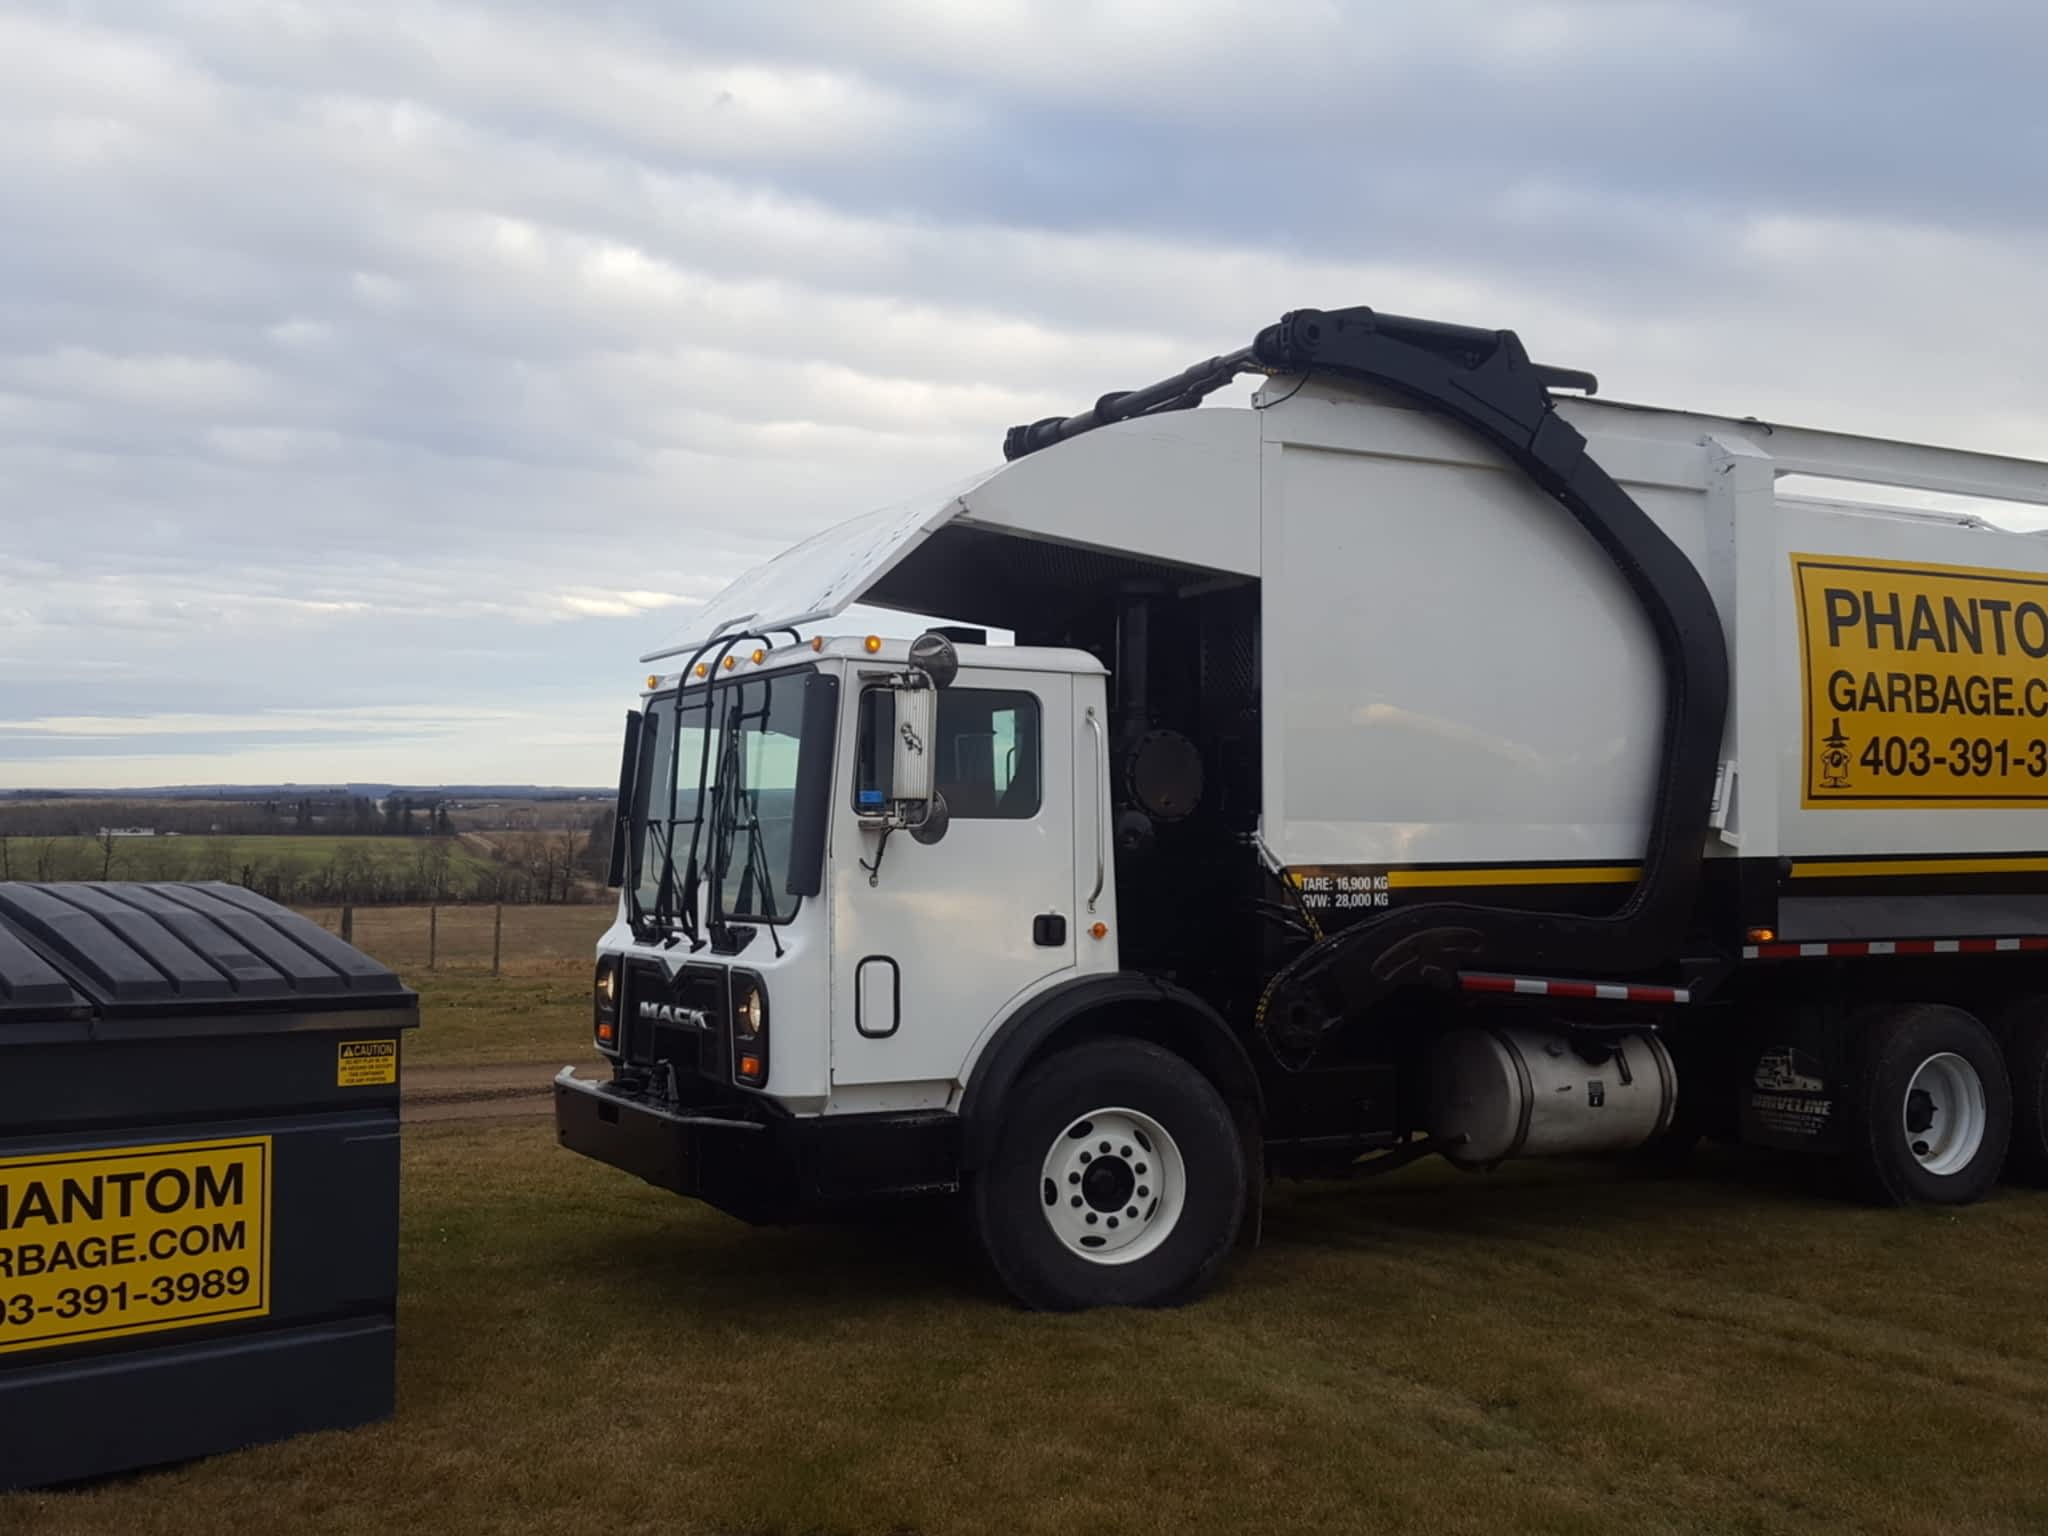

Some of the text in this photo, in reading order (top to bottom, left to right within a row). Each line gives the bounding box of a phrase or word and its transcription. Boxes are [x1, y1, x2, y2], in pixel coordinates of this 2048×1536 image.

[1824, 588, 2048, 658] PHANTO
[1828, 670, 2048, 717] GARBAGE.C
[1860, 736, 2048, 777] 403-391-3
[1303, 876, 1389, 893] TARE: 16,900 KG
[1336, 894, 1371, 909] 28,000
[1374, 893, 1389, 906] KG
[640, 1001, 707, 1029] MACK
[354, 1044, 393, 1056] CAUTION
[0, 1265, 250, 1327] 3-391-3989
